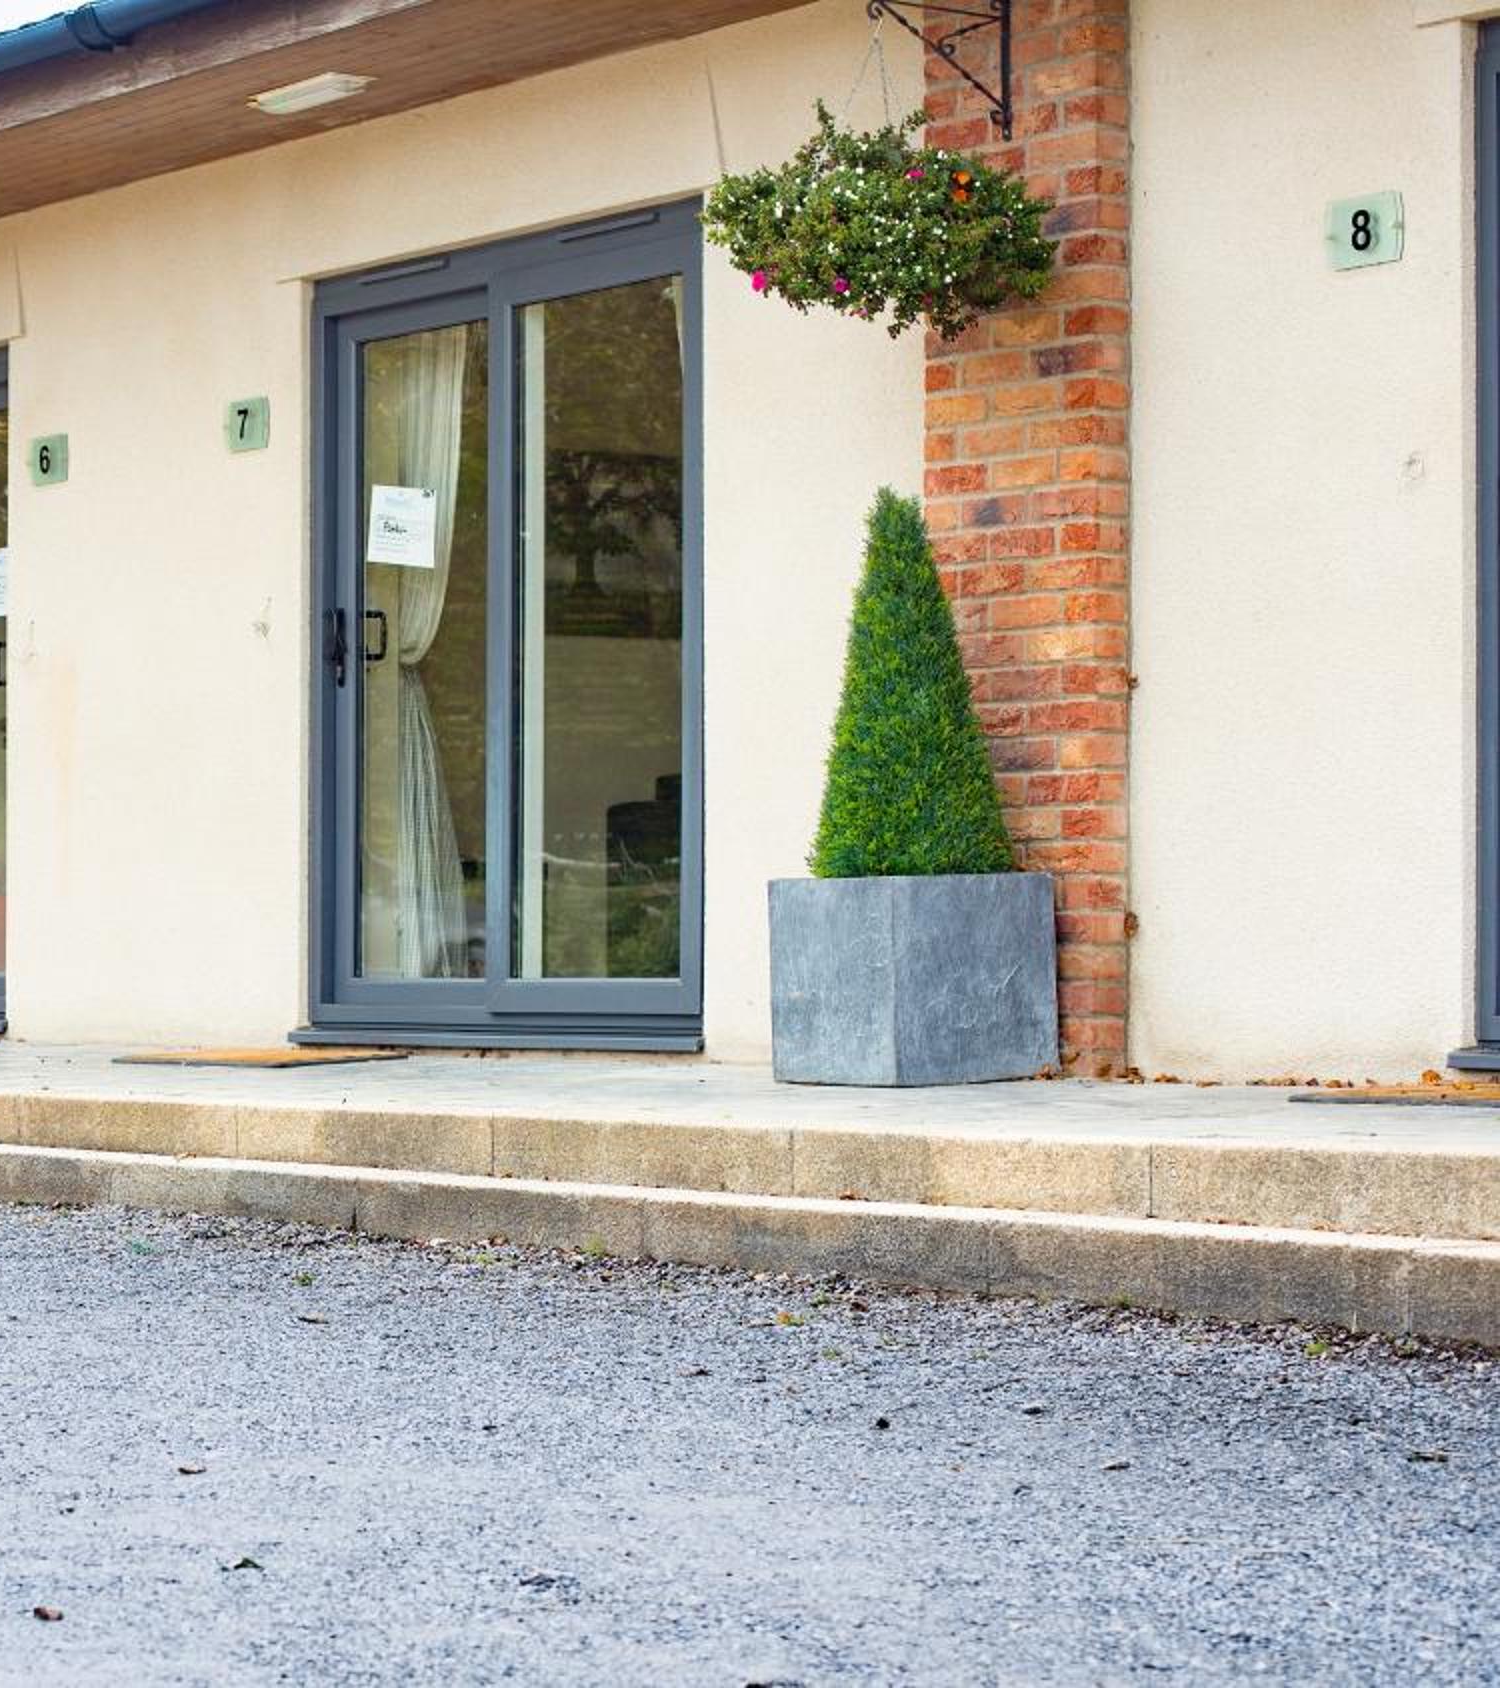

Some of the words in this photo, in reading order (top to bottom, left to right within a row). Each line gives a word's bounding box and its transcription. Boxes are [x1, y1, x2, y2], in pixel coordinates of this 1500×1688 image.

[1351, 209, 1372, 251] 8
[237, 408, 248, 440] 7
[39, 445, 50, 474] 6
